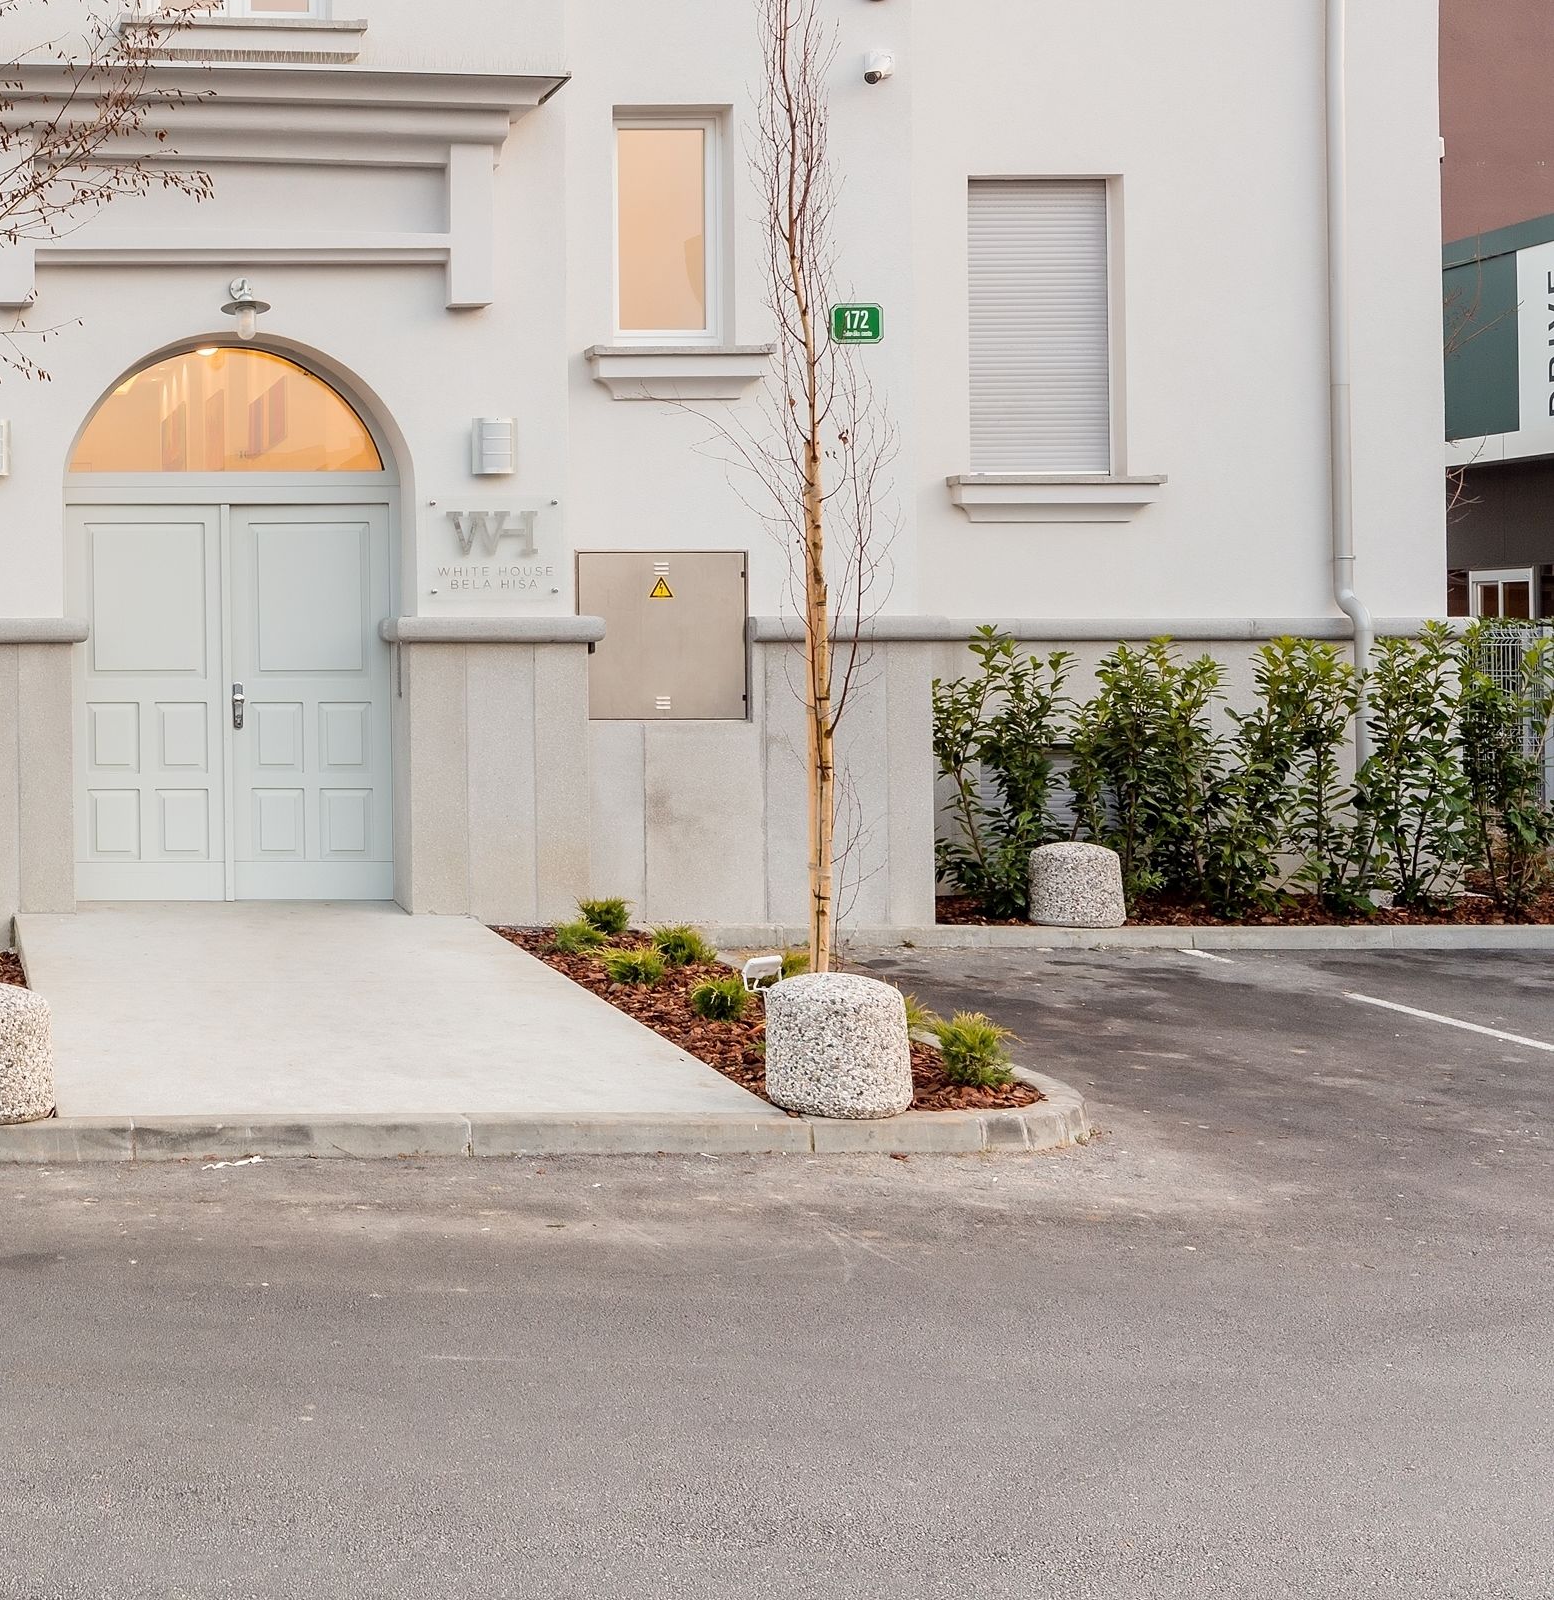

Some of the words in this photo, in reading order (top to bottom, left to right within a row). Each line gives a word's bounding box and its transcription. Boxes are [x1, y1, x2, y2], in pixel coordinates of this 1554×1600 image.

[845, 310, 869, 329] 172
[445, 510, 539, 557] WH
[437, 566, 490, 577] WHITE
[498, 566, 554, 577] HOUSE
[450, 579, 492, 590] BELA
